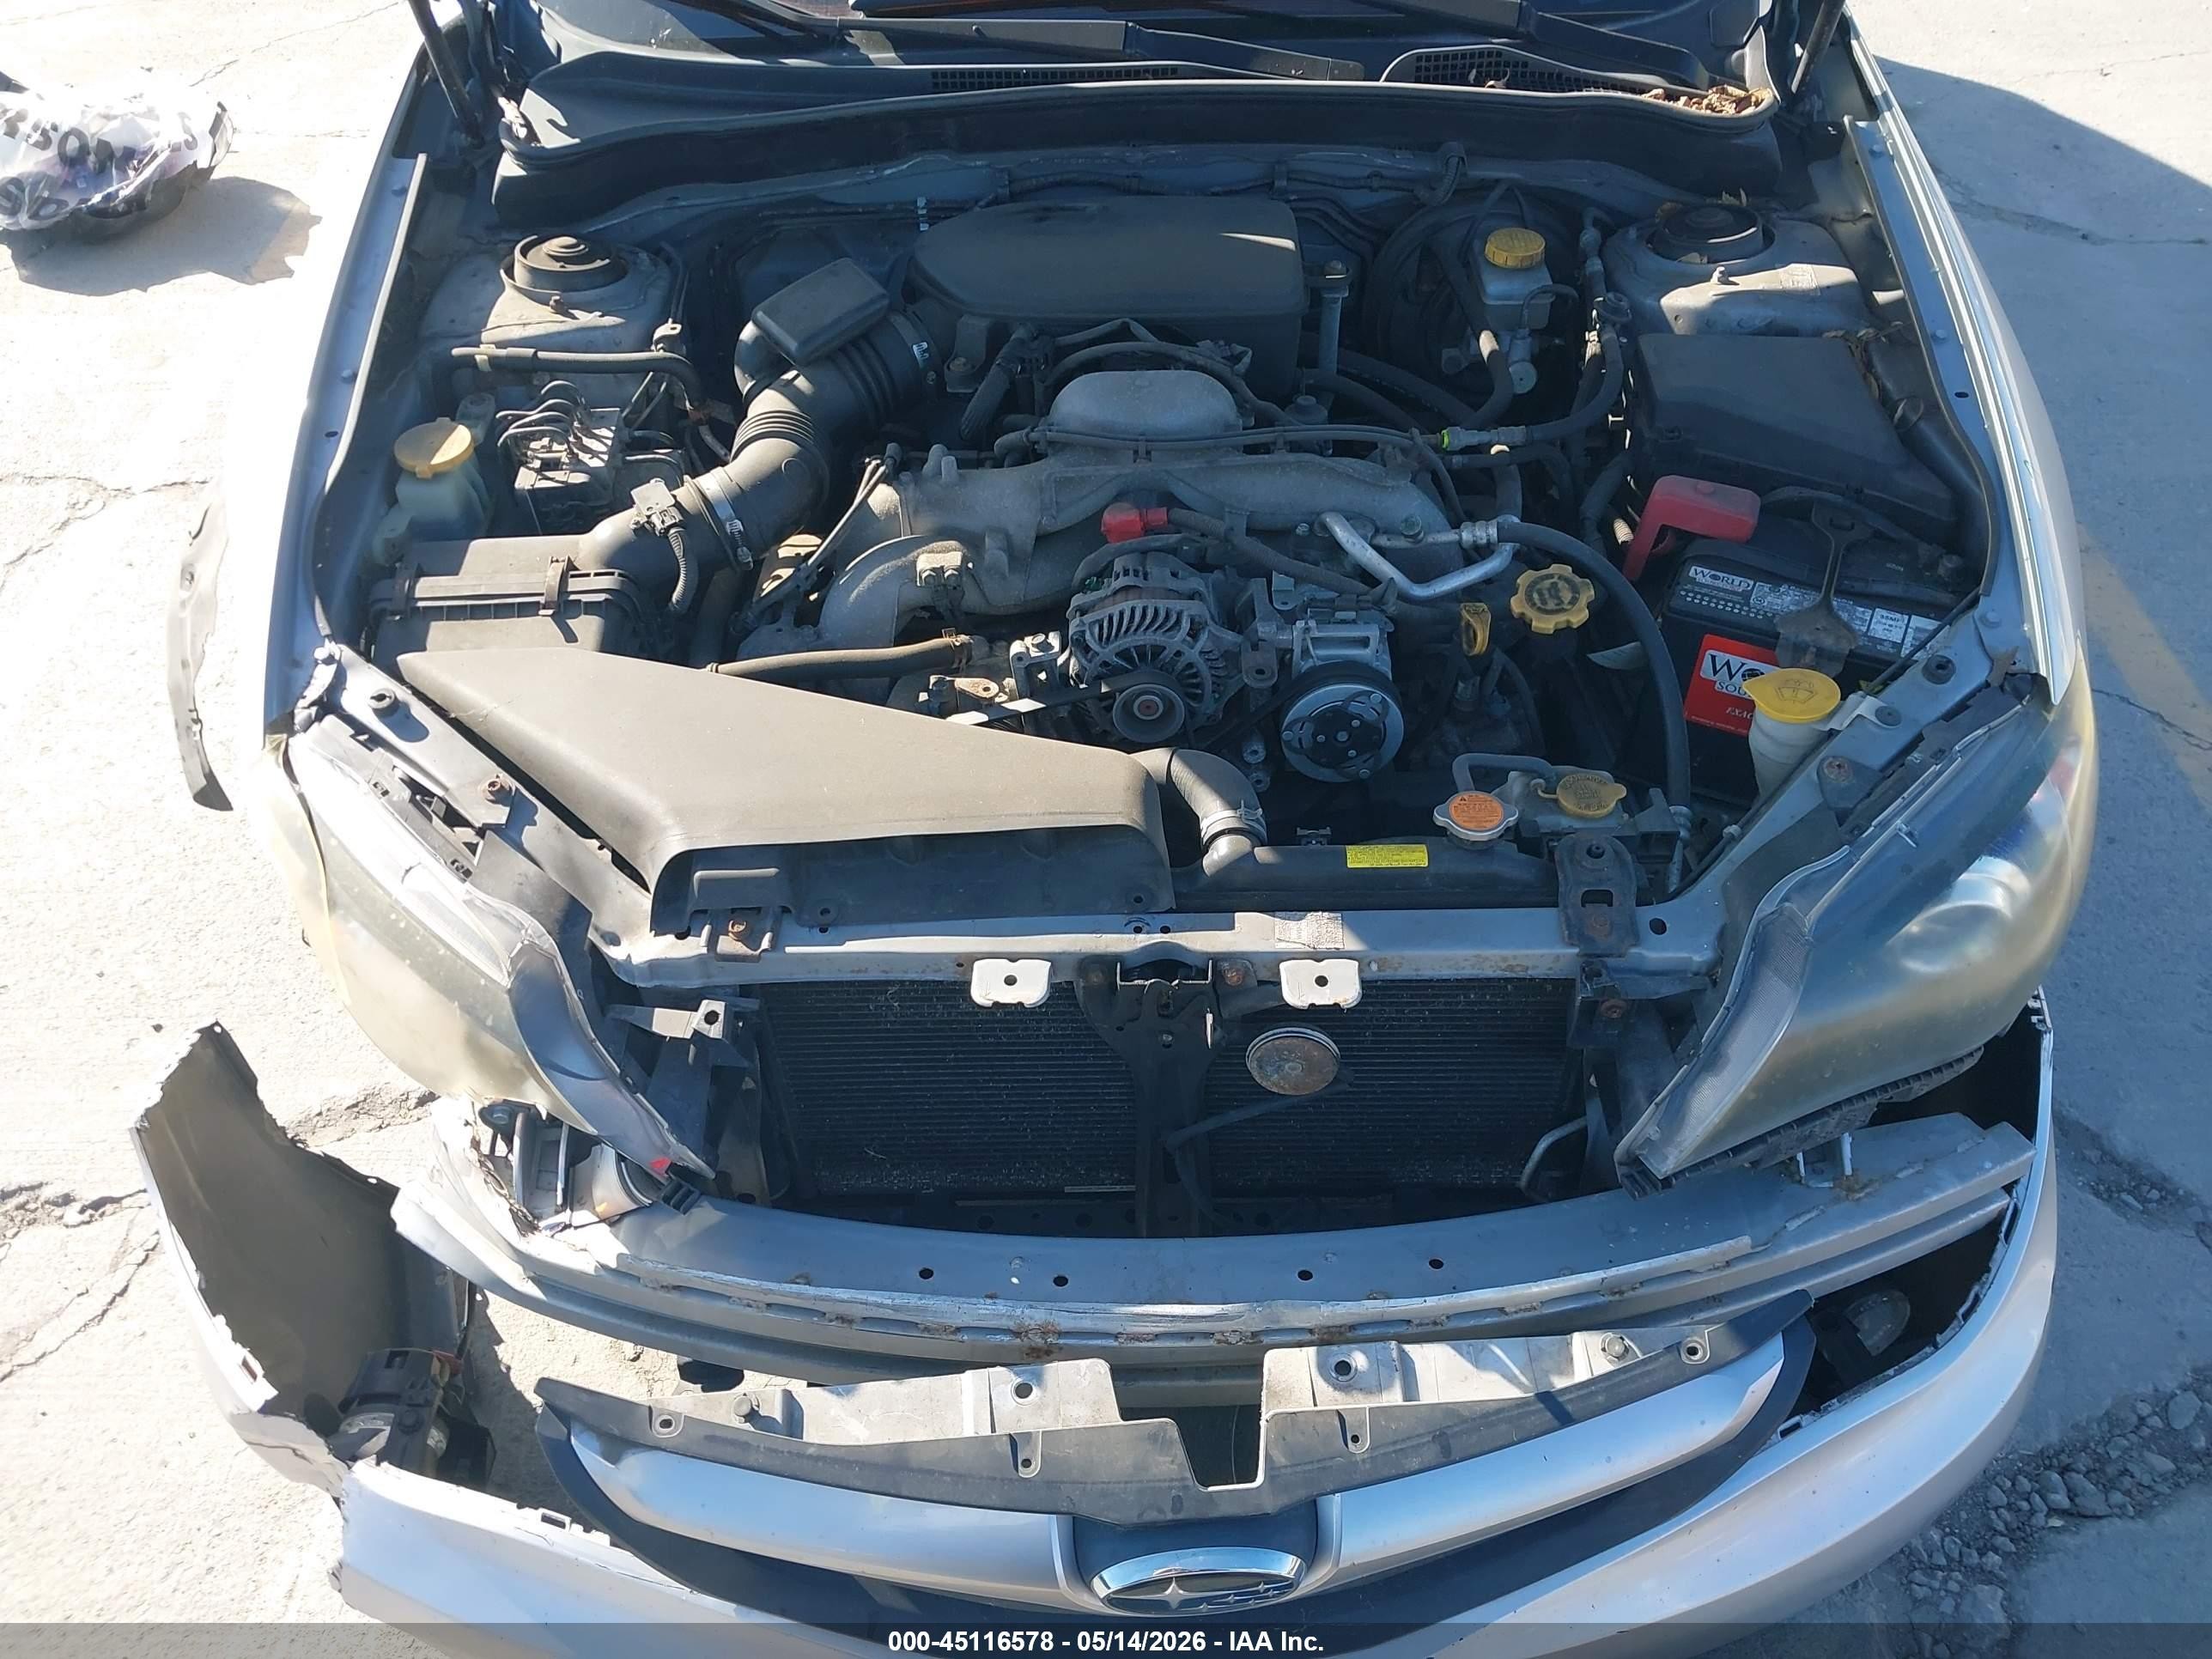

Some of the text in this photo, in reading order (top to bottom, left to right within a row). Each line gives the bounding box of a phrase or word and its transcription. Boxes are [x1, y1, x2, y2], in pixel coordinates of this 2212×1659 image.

[1692, 568, 1751, 589] WORLD
[1717, 680, 1750, 697] SOU
[1725, 706, 1753, 720] EXAC
